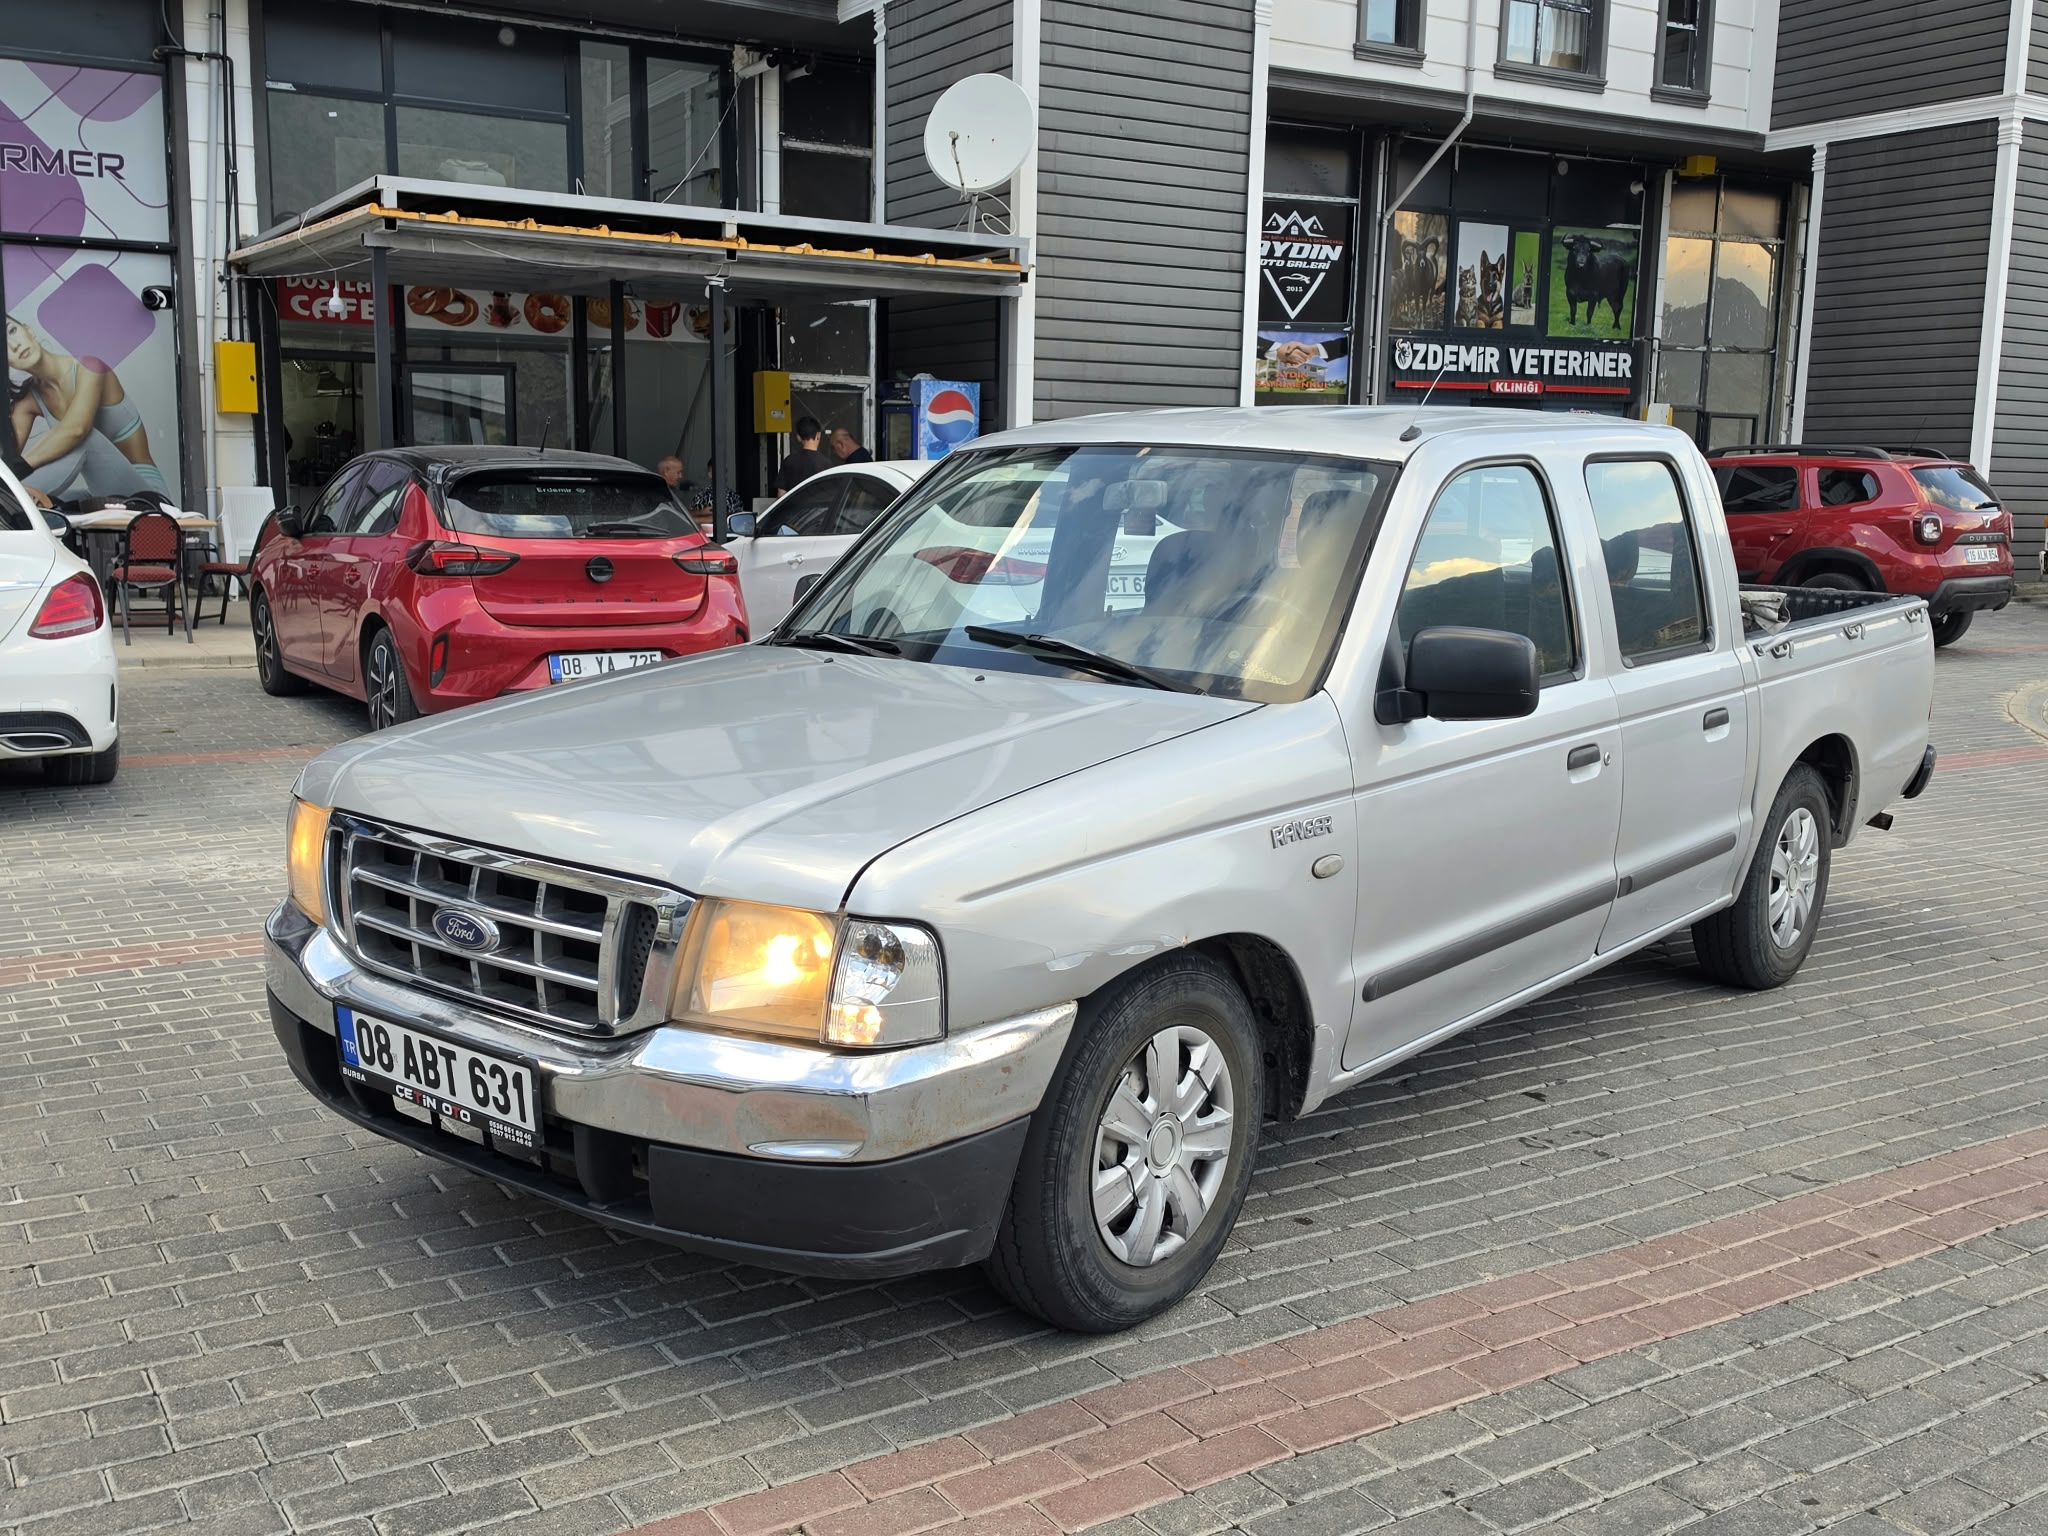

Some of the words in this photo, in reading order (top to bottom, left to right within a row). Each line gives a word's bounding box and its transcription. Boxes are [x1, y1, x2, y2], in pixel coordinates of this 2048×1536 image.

[0, 143, 125, 180] RMER
[1260, 258, 1285, 267] OTO
[561, 658, 582, 675] 08
[596, 656, 616, 674] YA
[1270, 814, 1334, 849] RANGER
[446, 917, 475, 941] Ford
[343, 1039, 356, 1055] TR
[356, 1018, 394, 1073] 08
[403, 1034, 457, 1097] ABT
[468, 1057, 527, 1123] 631
[343, 1067, 366, 1082] BURSA
[441, 1104, 472, 1123] OTO
